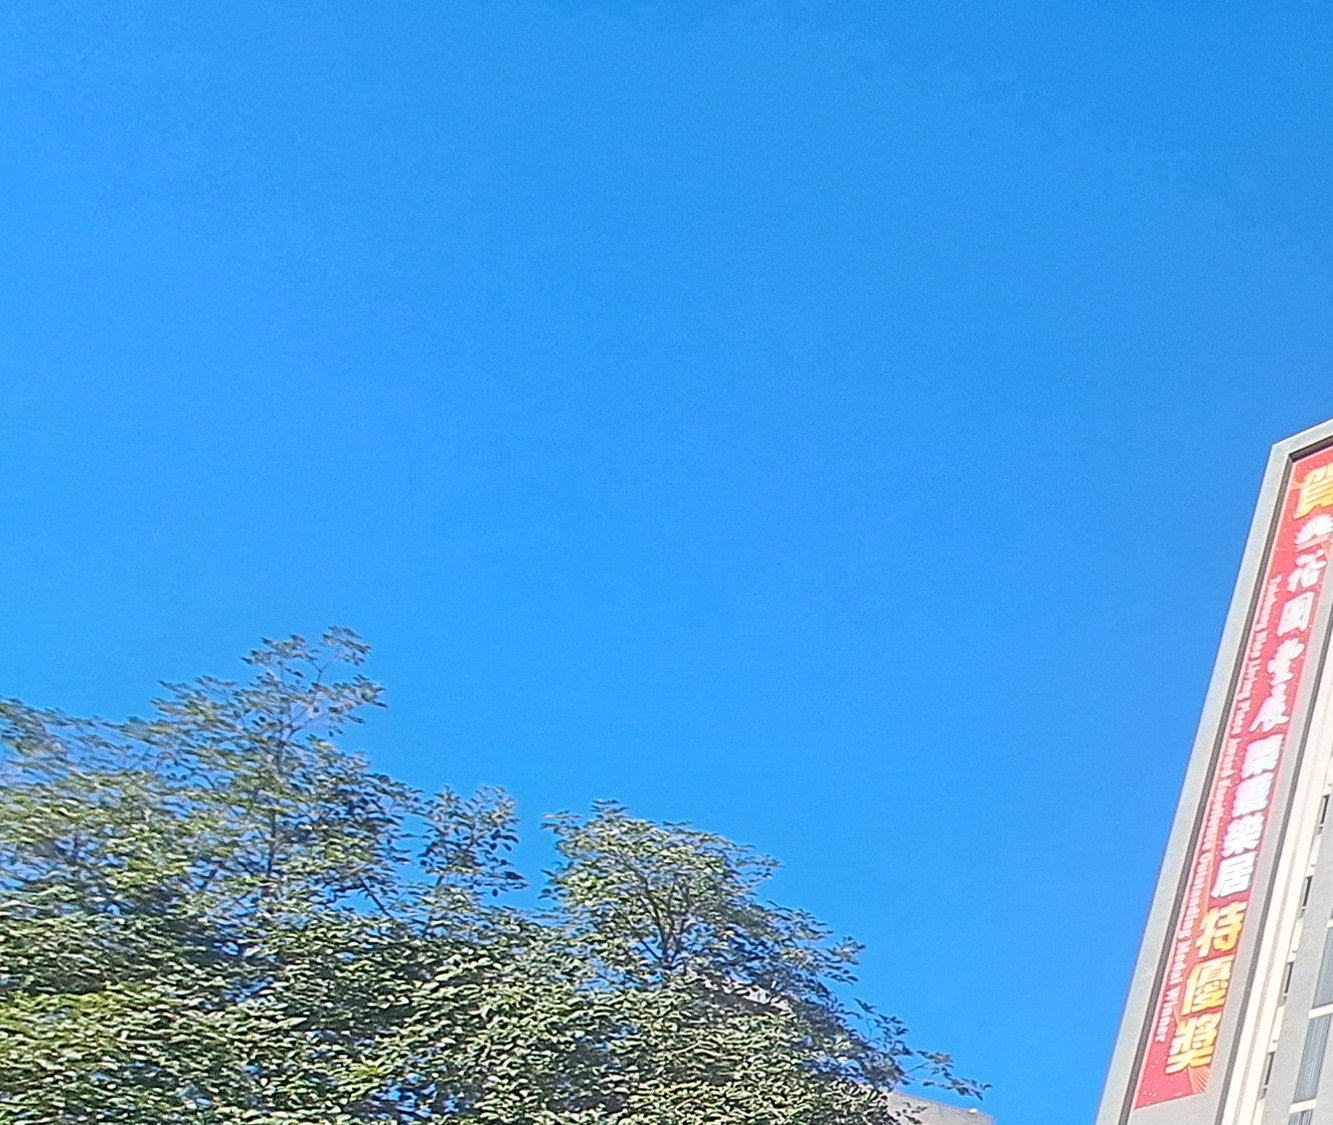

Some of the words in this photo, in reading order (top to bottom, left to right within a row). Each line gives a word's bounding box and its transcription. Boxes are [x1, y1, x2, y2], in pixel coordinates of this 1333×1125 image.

[1254, 574, 1282, 632] Taichung
[1236, 657, 1262, 702] Living
[1229, 698, 1252, 736] Place
[1218, 734, 1243, 778] Award
[1200, 776, 1232, 851] Excellence
[1177, 849, 1214, 941] Outstanding
[1167, 938, 1192, 986] Medal
[1152, 983, 1181, 1043] Winner
